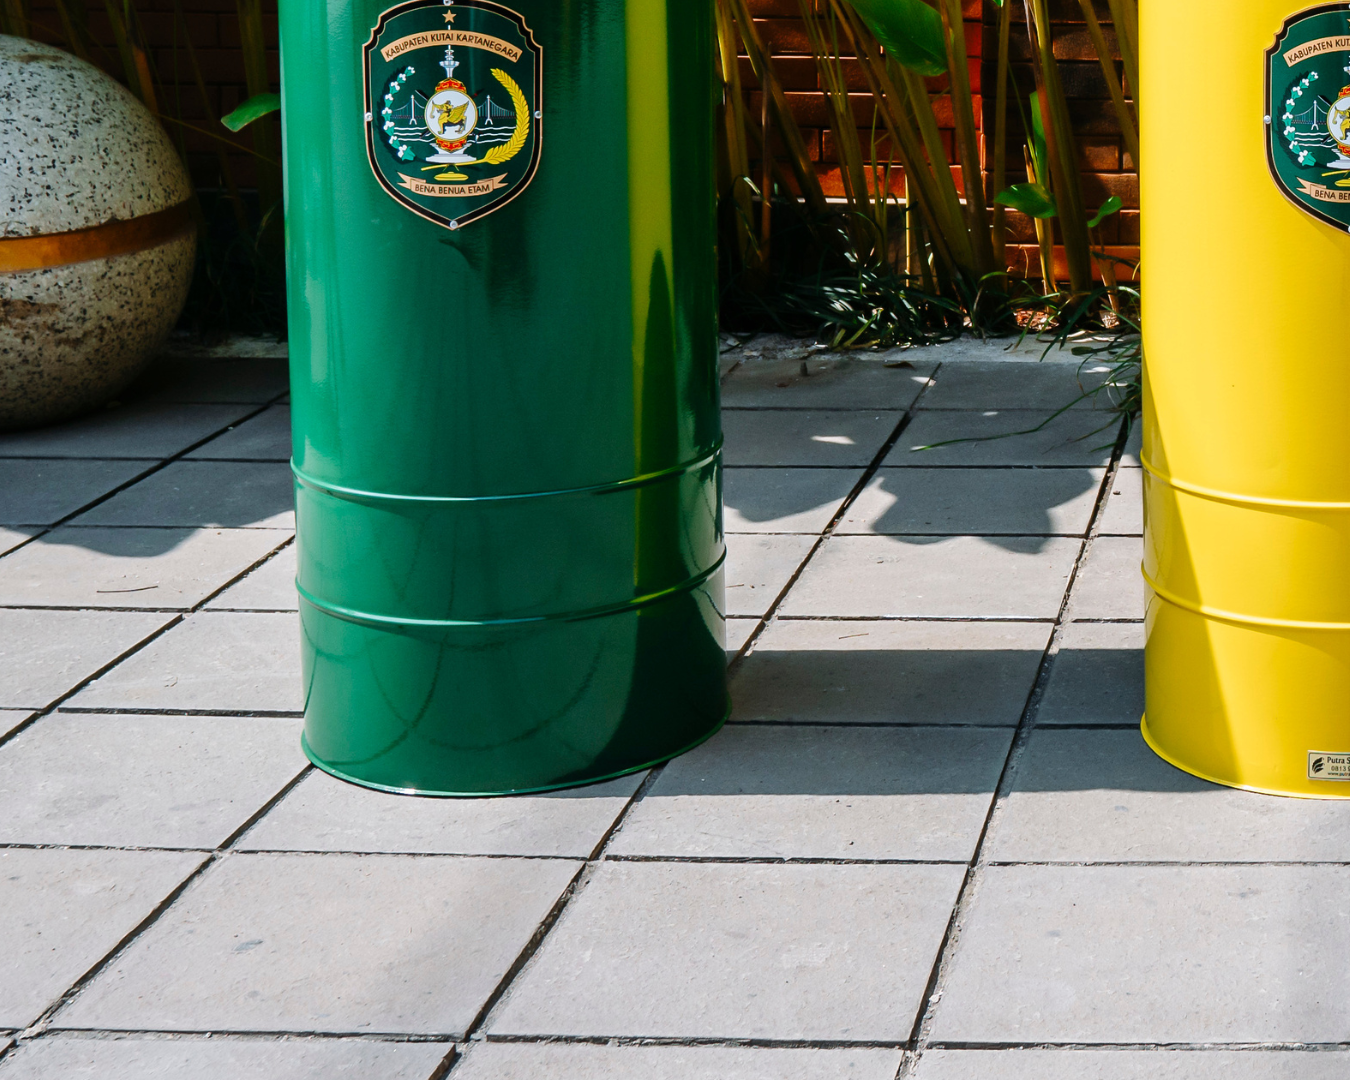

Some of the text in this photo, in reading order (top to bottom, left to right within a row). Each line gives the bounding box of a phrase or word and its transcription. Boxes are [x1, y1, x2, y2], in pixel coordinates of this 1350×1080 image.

[384, 32, 519, 60] KABUPATEN KUTAI KARTANEGARA
[1287, 40, 1333, 64] KABUPATEN
[414, 183, 491, 195] BENA BENUA ETAM
[1314, 189, 1336, 200] BENA
[1327, 756, 1345, 764] Putra
